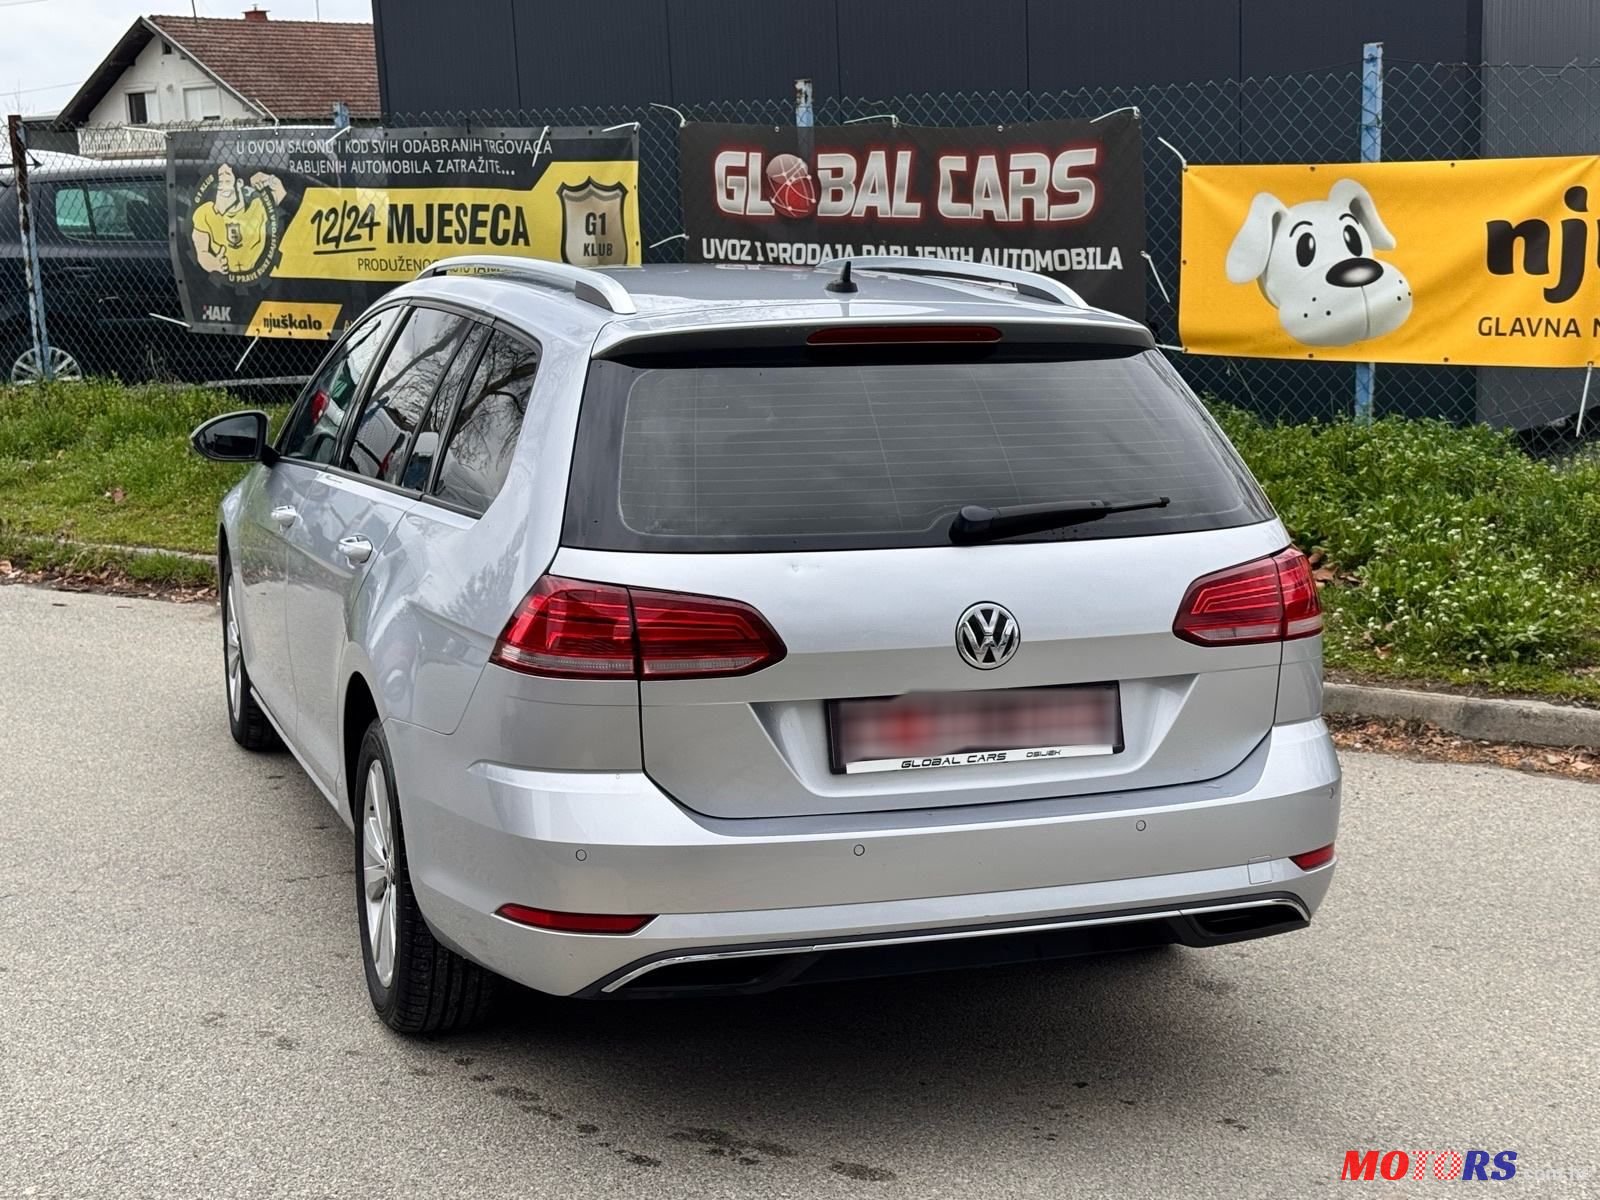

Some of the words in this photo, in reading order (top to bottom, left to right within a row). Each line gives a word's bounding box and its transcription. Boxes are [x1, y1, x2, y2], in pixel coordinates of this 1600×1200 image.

[236, 140, 245, 154] U
[247, 140, 286, 154] OVOM
[288, 140, 334, 154] SALONU
[345, 139, 370, 153] KOD
[372, 139, 399, 153] SVIH
[402, 138, 483, 153] ODABRANIH
[484, 139, 553, 154] TRGOVACA
[289, 160, 347, 176] RABLJENIH
[351, 159, 433, 174] AUTOMOBILA
[714, 150, 921, 219] GLOBAL
[938, 148, 1097, 222] CARS
[310, 200, 381, 249] 12/24
[387, 203, 531, 247] MJESECA
[585, 212, 607, 236] G1
[583, 242, 613, 257] KLUB
[702, 238, 752, 261] UVOZ
[756, 241, 765, 262] I
[765, 242, 856, 266] PRODAJA
[980, 246, 1124, 272] AUTOMOBILA
[263, 312, 322, 333] njuškalo
[1478, 316, 1581, 338] GLAVNA
[901, 756, 960, 769] GLOBAL
[966, 752, 1007, 763] CARS
